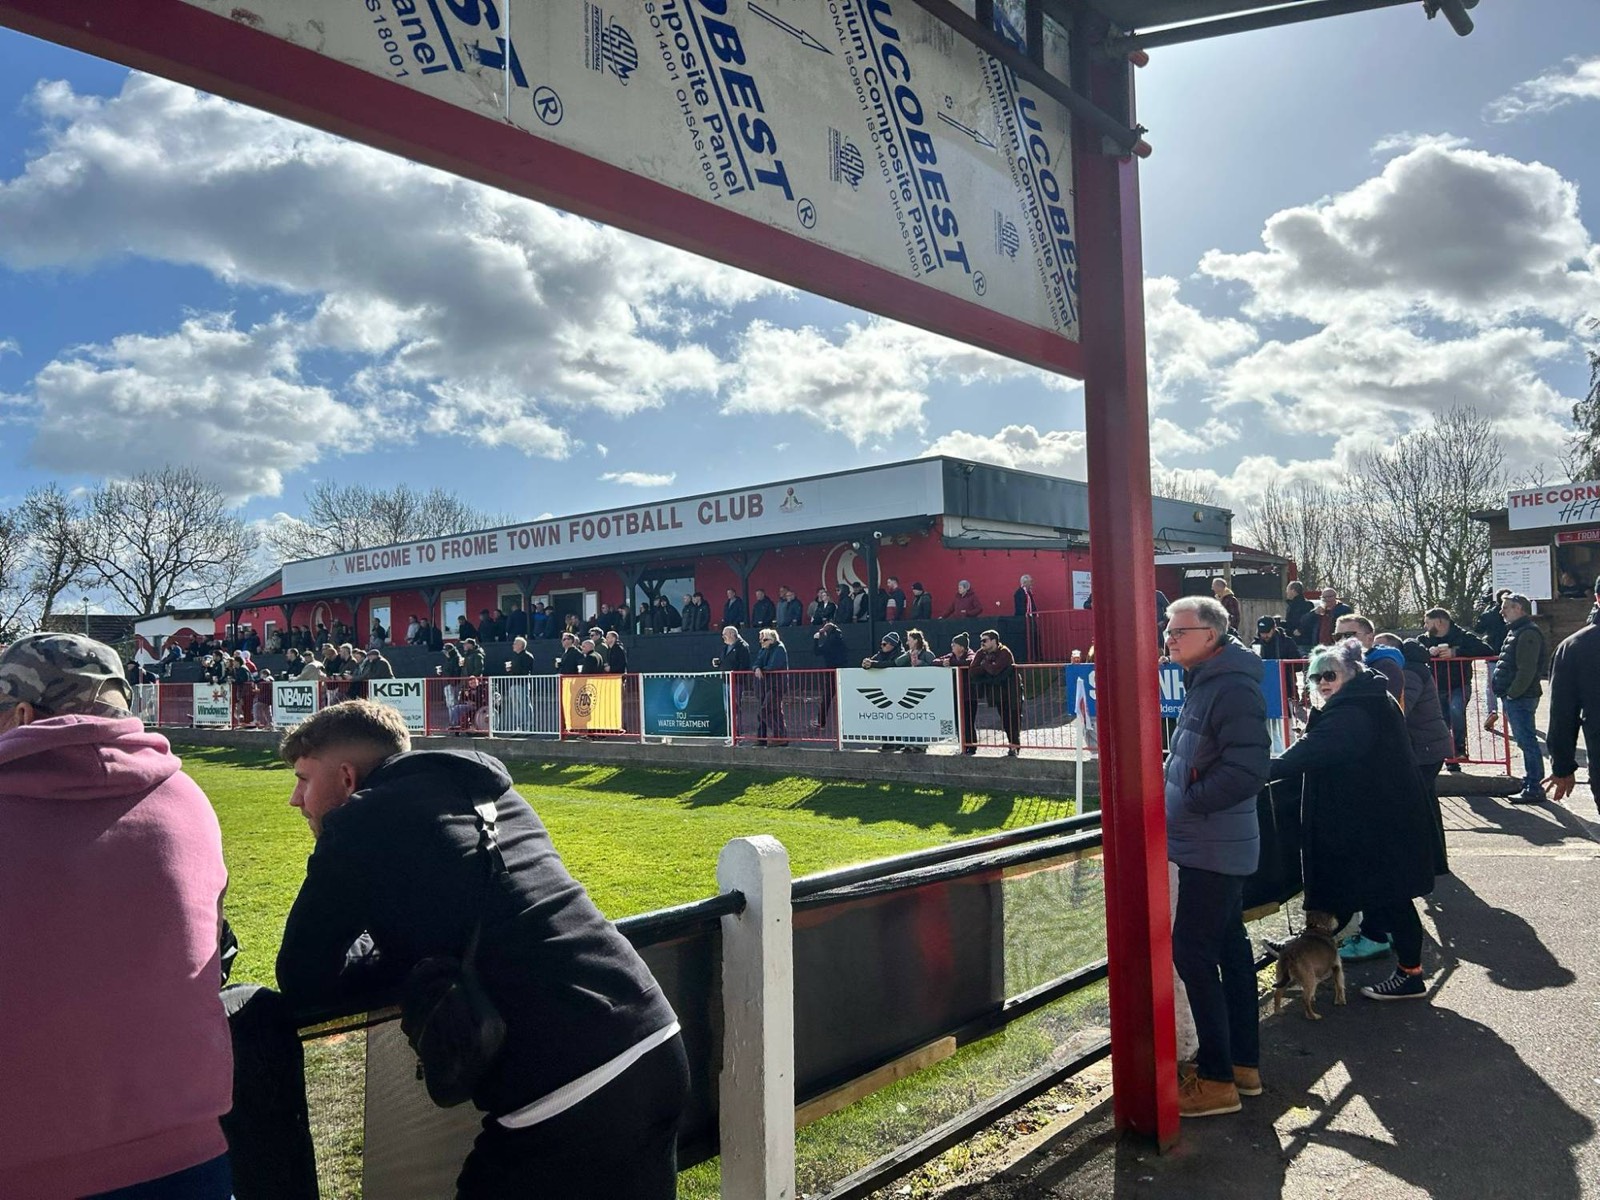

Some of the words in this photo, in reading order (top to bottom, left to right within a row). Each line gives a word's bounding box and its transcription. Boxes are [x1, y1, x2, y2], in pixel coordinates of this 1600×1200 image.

[676, 88, 722, 200] OHSAS18001
[703, 113, 745, 196] Panel
[844, 50, 868, 111] ISO9001
[866, 117, 892, 184] ISO14001
[889, 189, 921, 278] OHSAS18001
[863, 66, 913, 203] Composite
[907, 207, 937, 275] Panel
[986, 53, 1020, 151] uminium
[1017, 156, 1053, 268] Composite
[1050, 274, 1073, 328] Panel
[345, 547, 411, 574] WELCOME
[416, 543, 436, 563] TO
[442, 533, 498, 560] FROME
[507, 525, 561, 551] TOWN
[569, 507, 683, 543] FOOTBALL
[698, 493, 764, 525] CLUB
[1510, 493, 1543, 508] THE
[373, 682, 421, 697] KGM
[657, 719, 675, 727] WATER
[676, 720, 710, 728] TREATMENT
[858, 712, 893, 720] HYBRID
[896, 712, 936, 721] SPORTS
